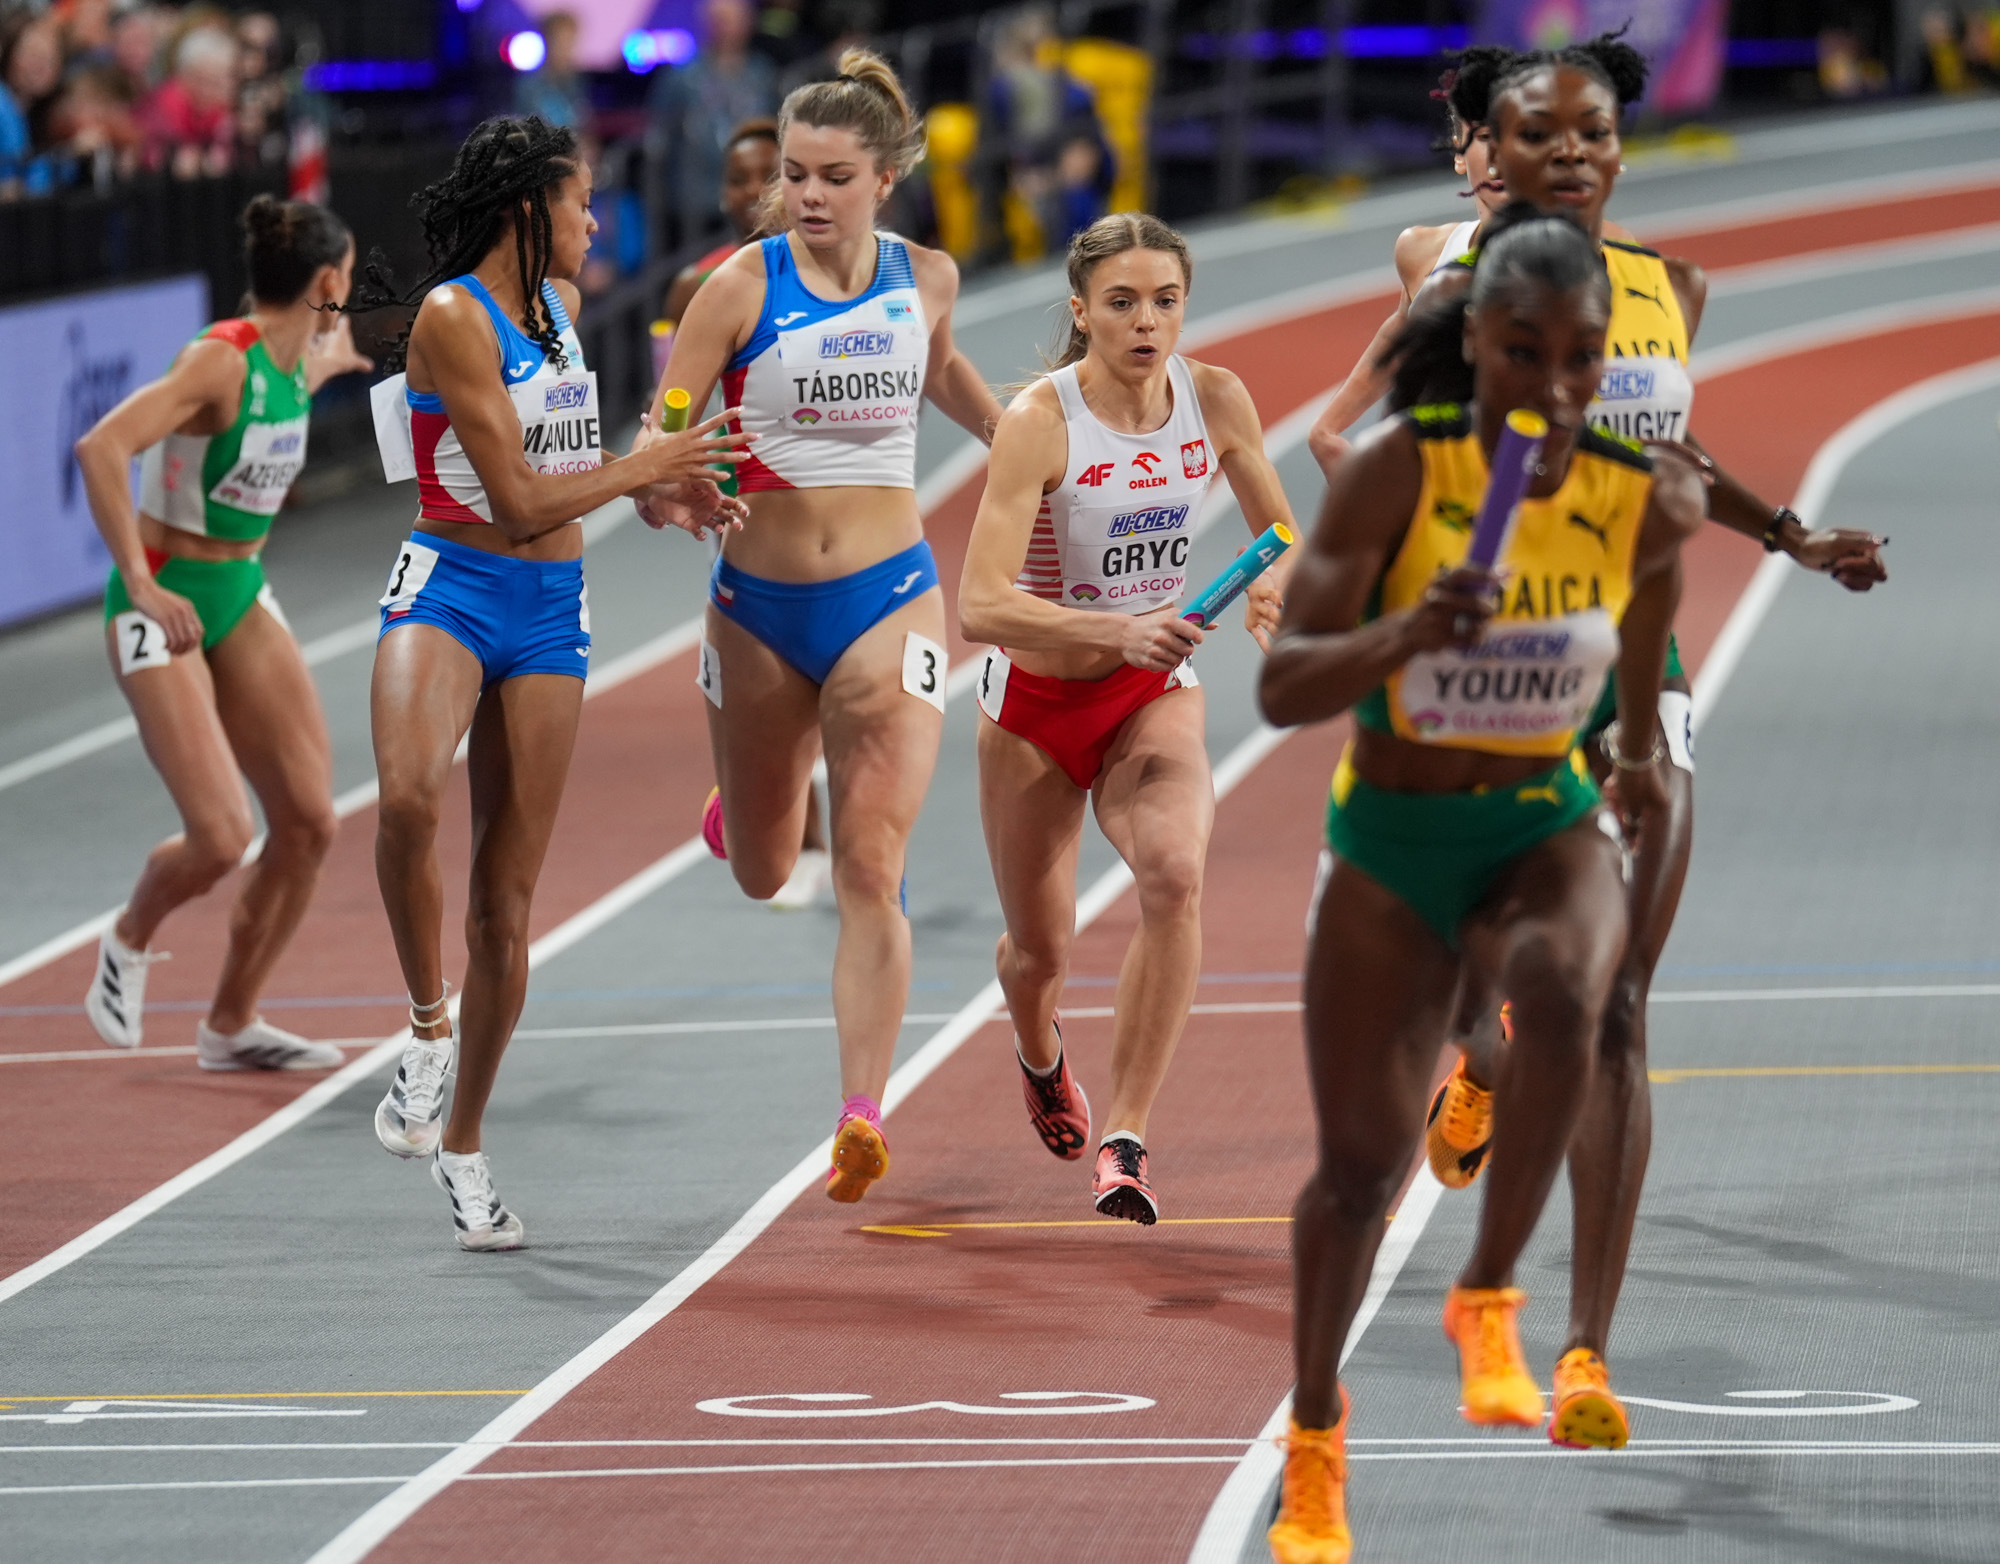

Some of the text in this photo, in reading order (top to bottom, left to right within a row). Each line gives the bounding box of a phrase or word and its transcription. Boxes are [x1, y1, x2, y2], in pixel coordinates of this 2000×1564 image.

[818, 331, 893, 359] HI-CHEW
[545, 382, 589, 412] HI-CHEW
[792, 365, 917, 403] TÁBORSKÁ
[1597, 370, 1654, 400] CHEW
[828, 406, 909, 423] GLASGOW
[1077, 463, 1115, 488] 4F
[1129, 476, 1167, 490] ORLEN
[1107, 503, 1189, 539] HI-CHEW
[1102, 536, 1189, 578] GRYC
[1257, 547, 1276, 565] 4
[390, 554, 411, 597] 3
[130, 622, 149, 660] 2
[920, 650, 936, 693] 3
[1433, 667, 1583, 703] YOUNG
